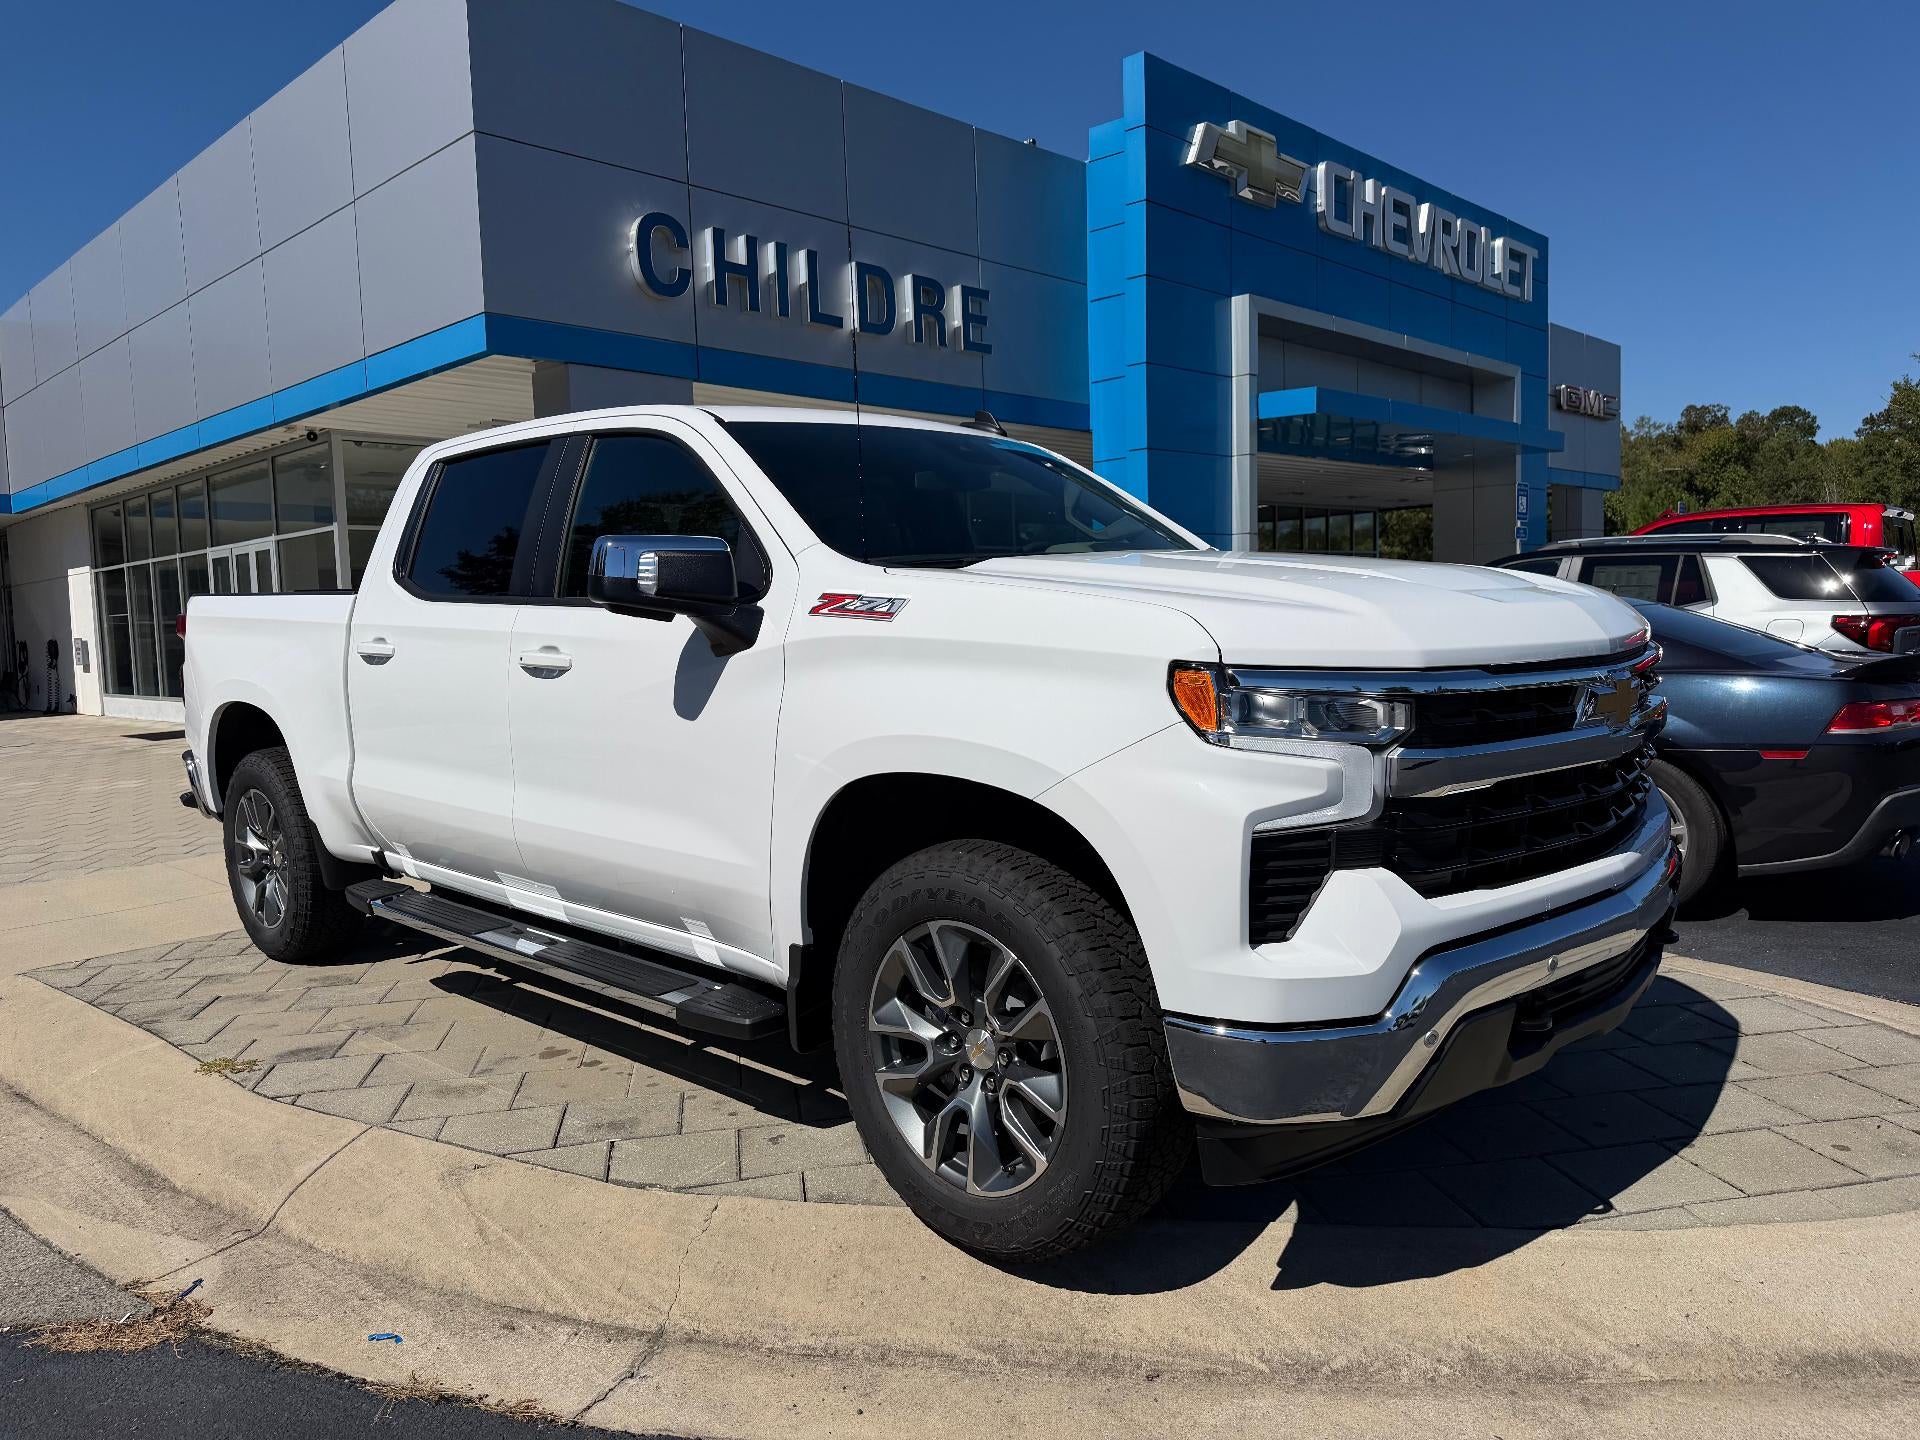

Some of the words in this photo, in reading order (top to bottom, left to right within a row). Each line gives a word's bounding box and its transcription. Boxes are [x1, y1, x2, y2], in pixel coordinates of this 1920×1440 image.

[629, 211, 992, 355] CHILDRE
[1316, 161, 1538, 302] CHEVROLET
[808, 592, 911, 622] Z71
